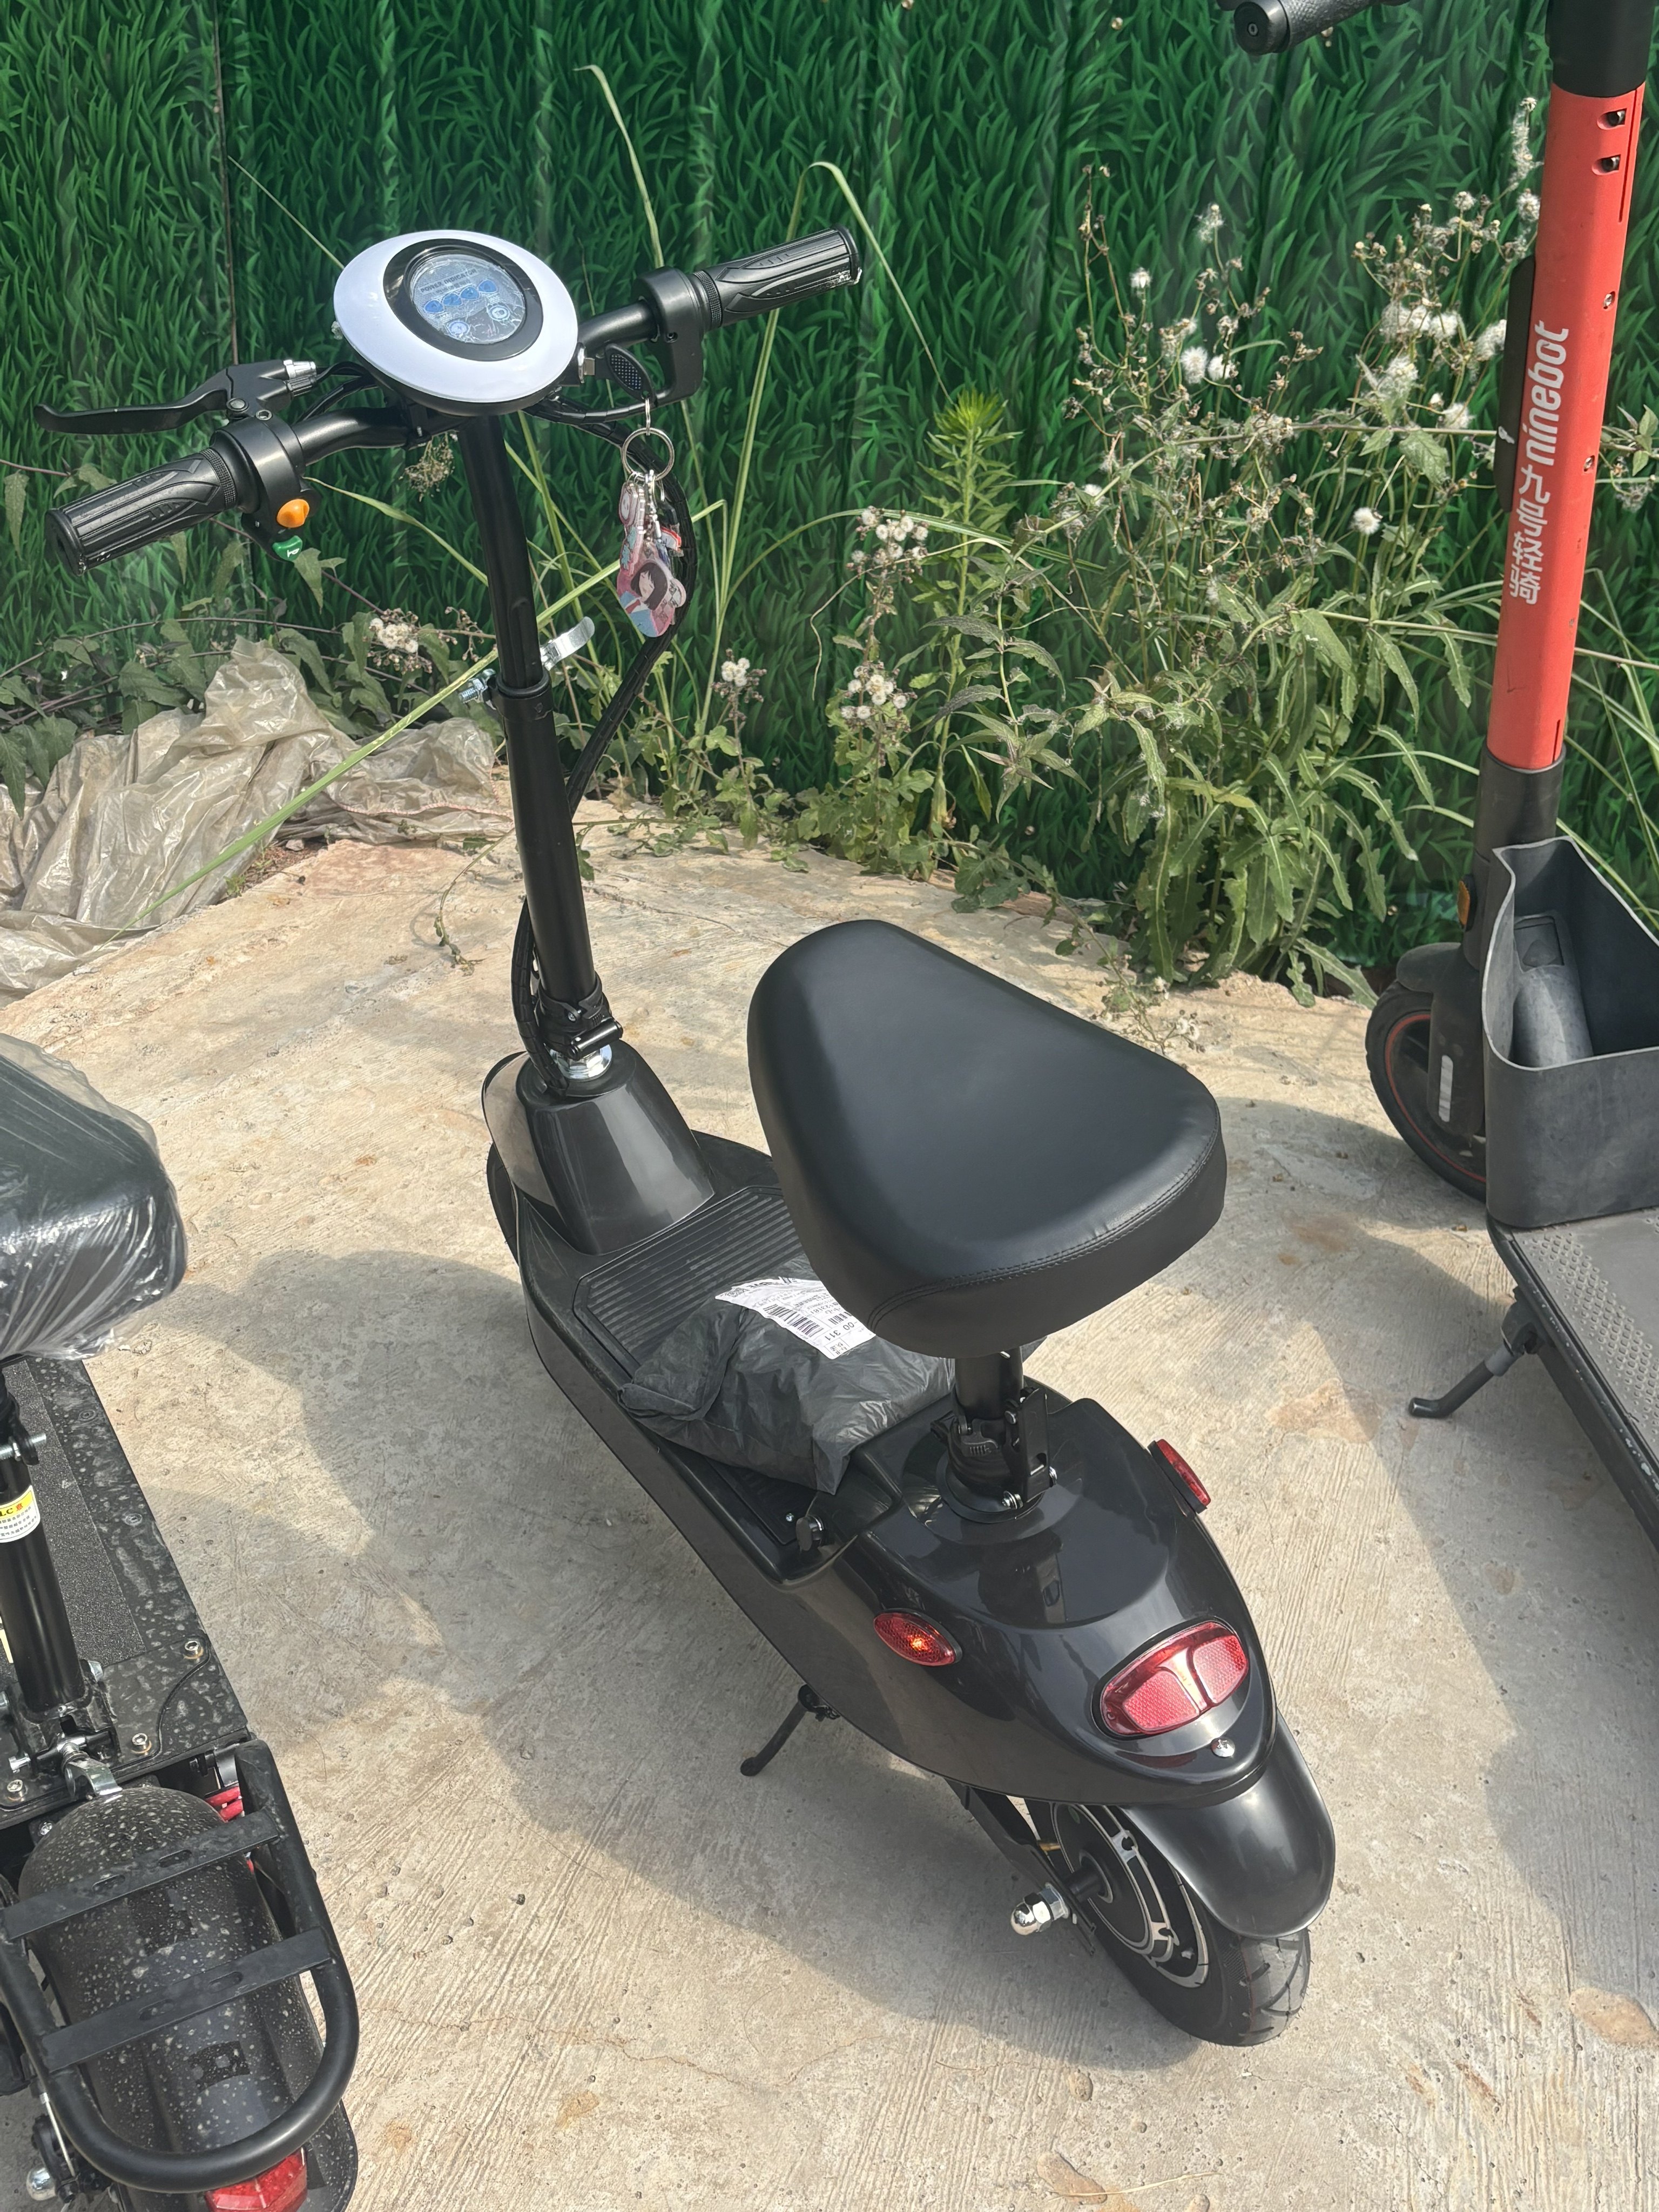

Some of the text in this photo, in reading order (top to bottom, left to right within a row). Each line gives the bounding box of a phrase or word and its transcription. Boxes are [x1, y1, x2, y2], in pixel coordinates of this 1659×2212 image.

[421, 282, 442, 293] POWER
[1522, 320, 1569, 466] ninebot
[1509, 464, 1550, 604] 九号轻骑
[824, 1330, 841, 1341] 311
